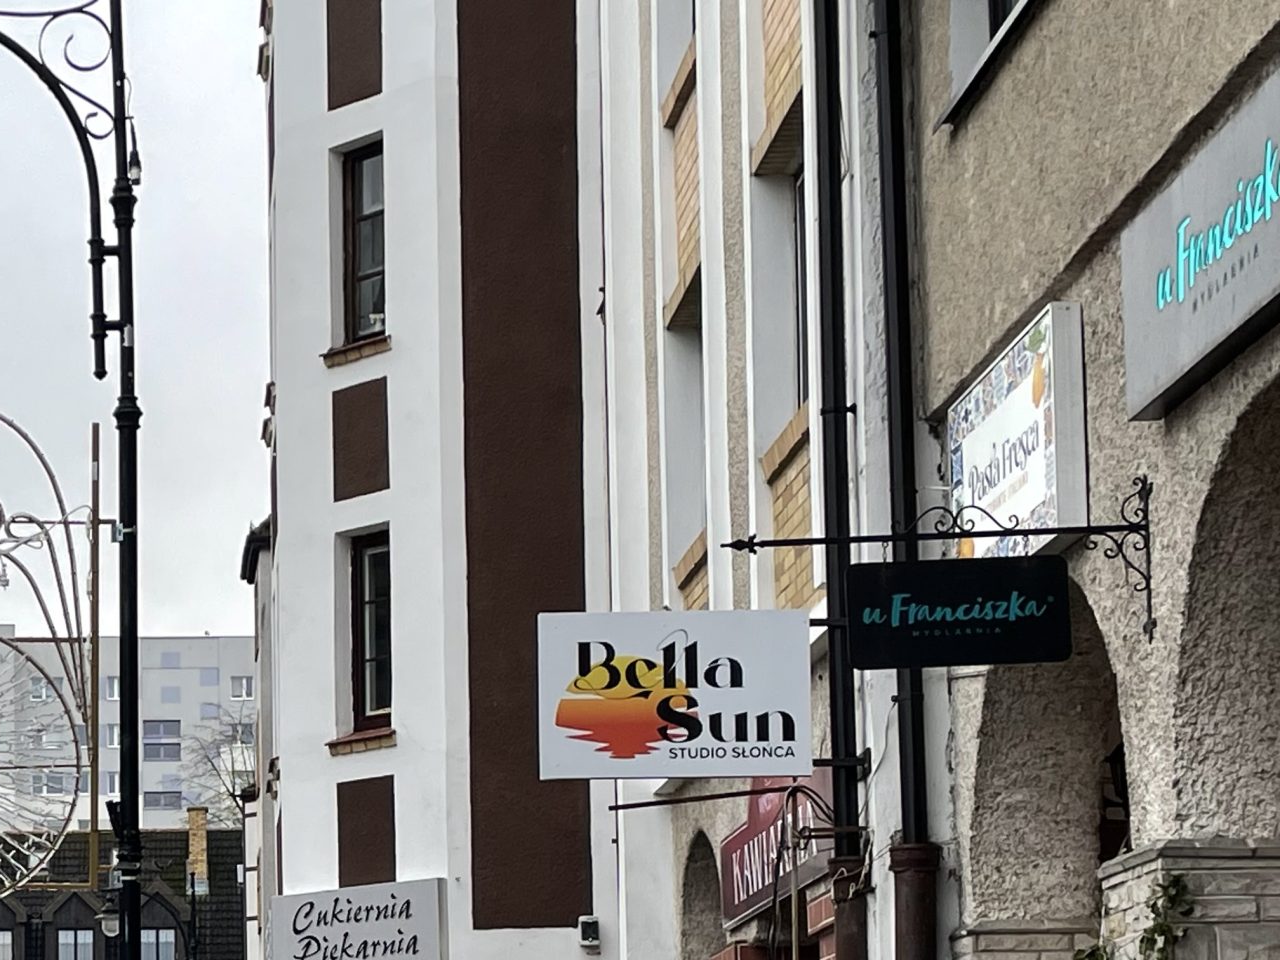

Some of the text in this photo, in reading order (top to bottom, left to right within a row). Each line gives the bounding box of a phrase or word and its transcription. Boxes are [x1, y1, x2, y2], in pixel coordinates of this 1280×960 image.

[1157, 138, 1280, 311] u Franciszk
[1001, 419, 1039, 480] Fresca
[862, 590, 1047, 628] u Franciszka
[574, 629, 745, 700] Bella
[656, 694, 796, 743] Sun
[669, 747, 727, 759] STUDIO
[292, 892, 413, 936] Cukiernia
